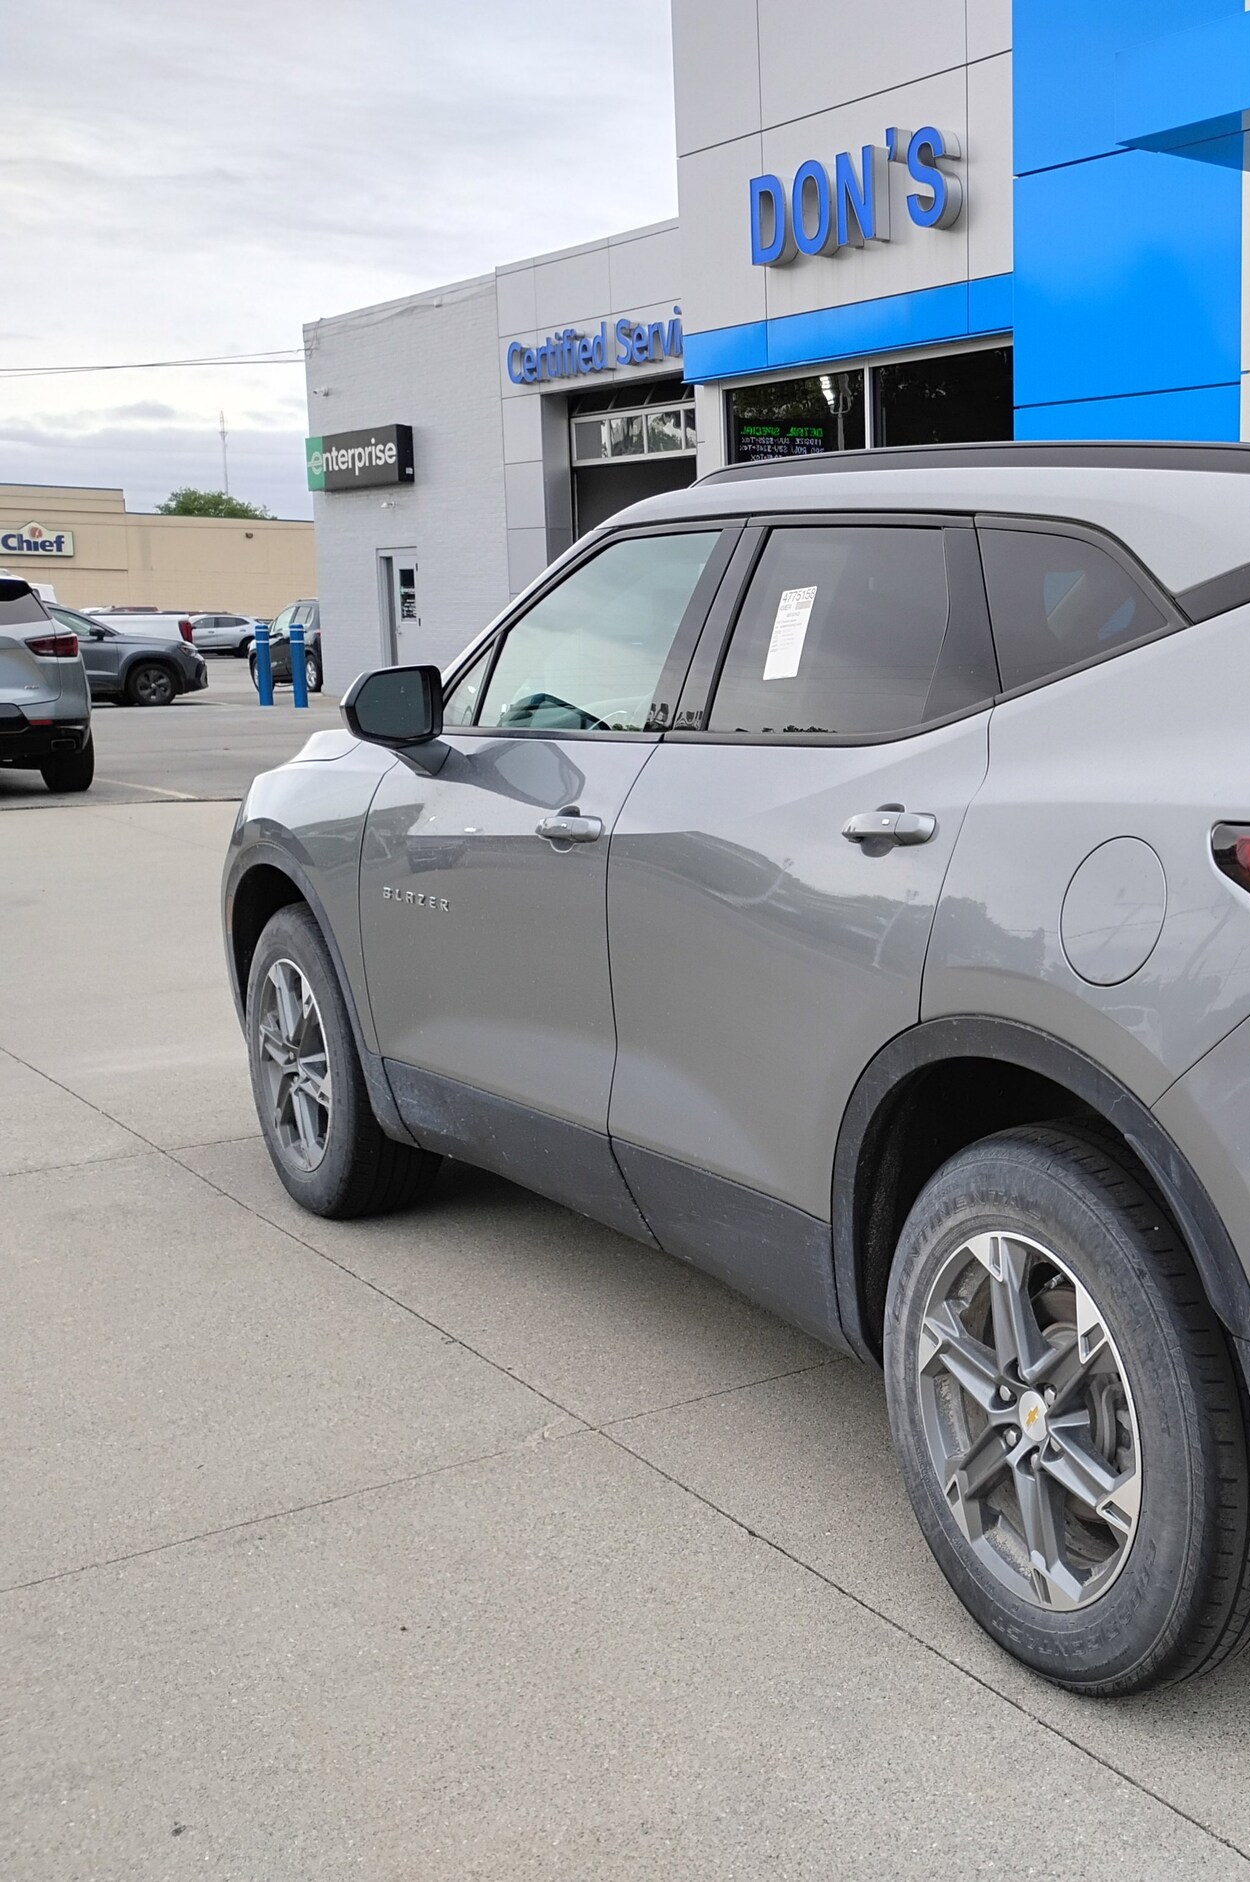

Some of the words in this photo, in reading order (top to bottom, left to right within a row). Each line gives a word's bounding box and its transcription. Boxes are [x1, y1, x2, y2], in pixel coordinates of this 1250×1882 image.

[749, 126, 957, 266] DON'S
[507, 321, 608, 385] Certified
[616, 305, 683, 366] Servi
[307, 437, 397, 476] enterprise
[1, 533, 65, 553] Chief
[383, 886, 450, 912] BLAZER
